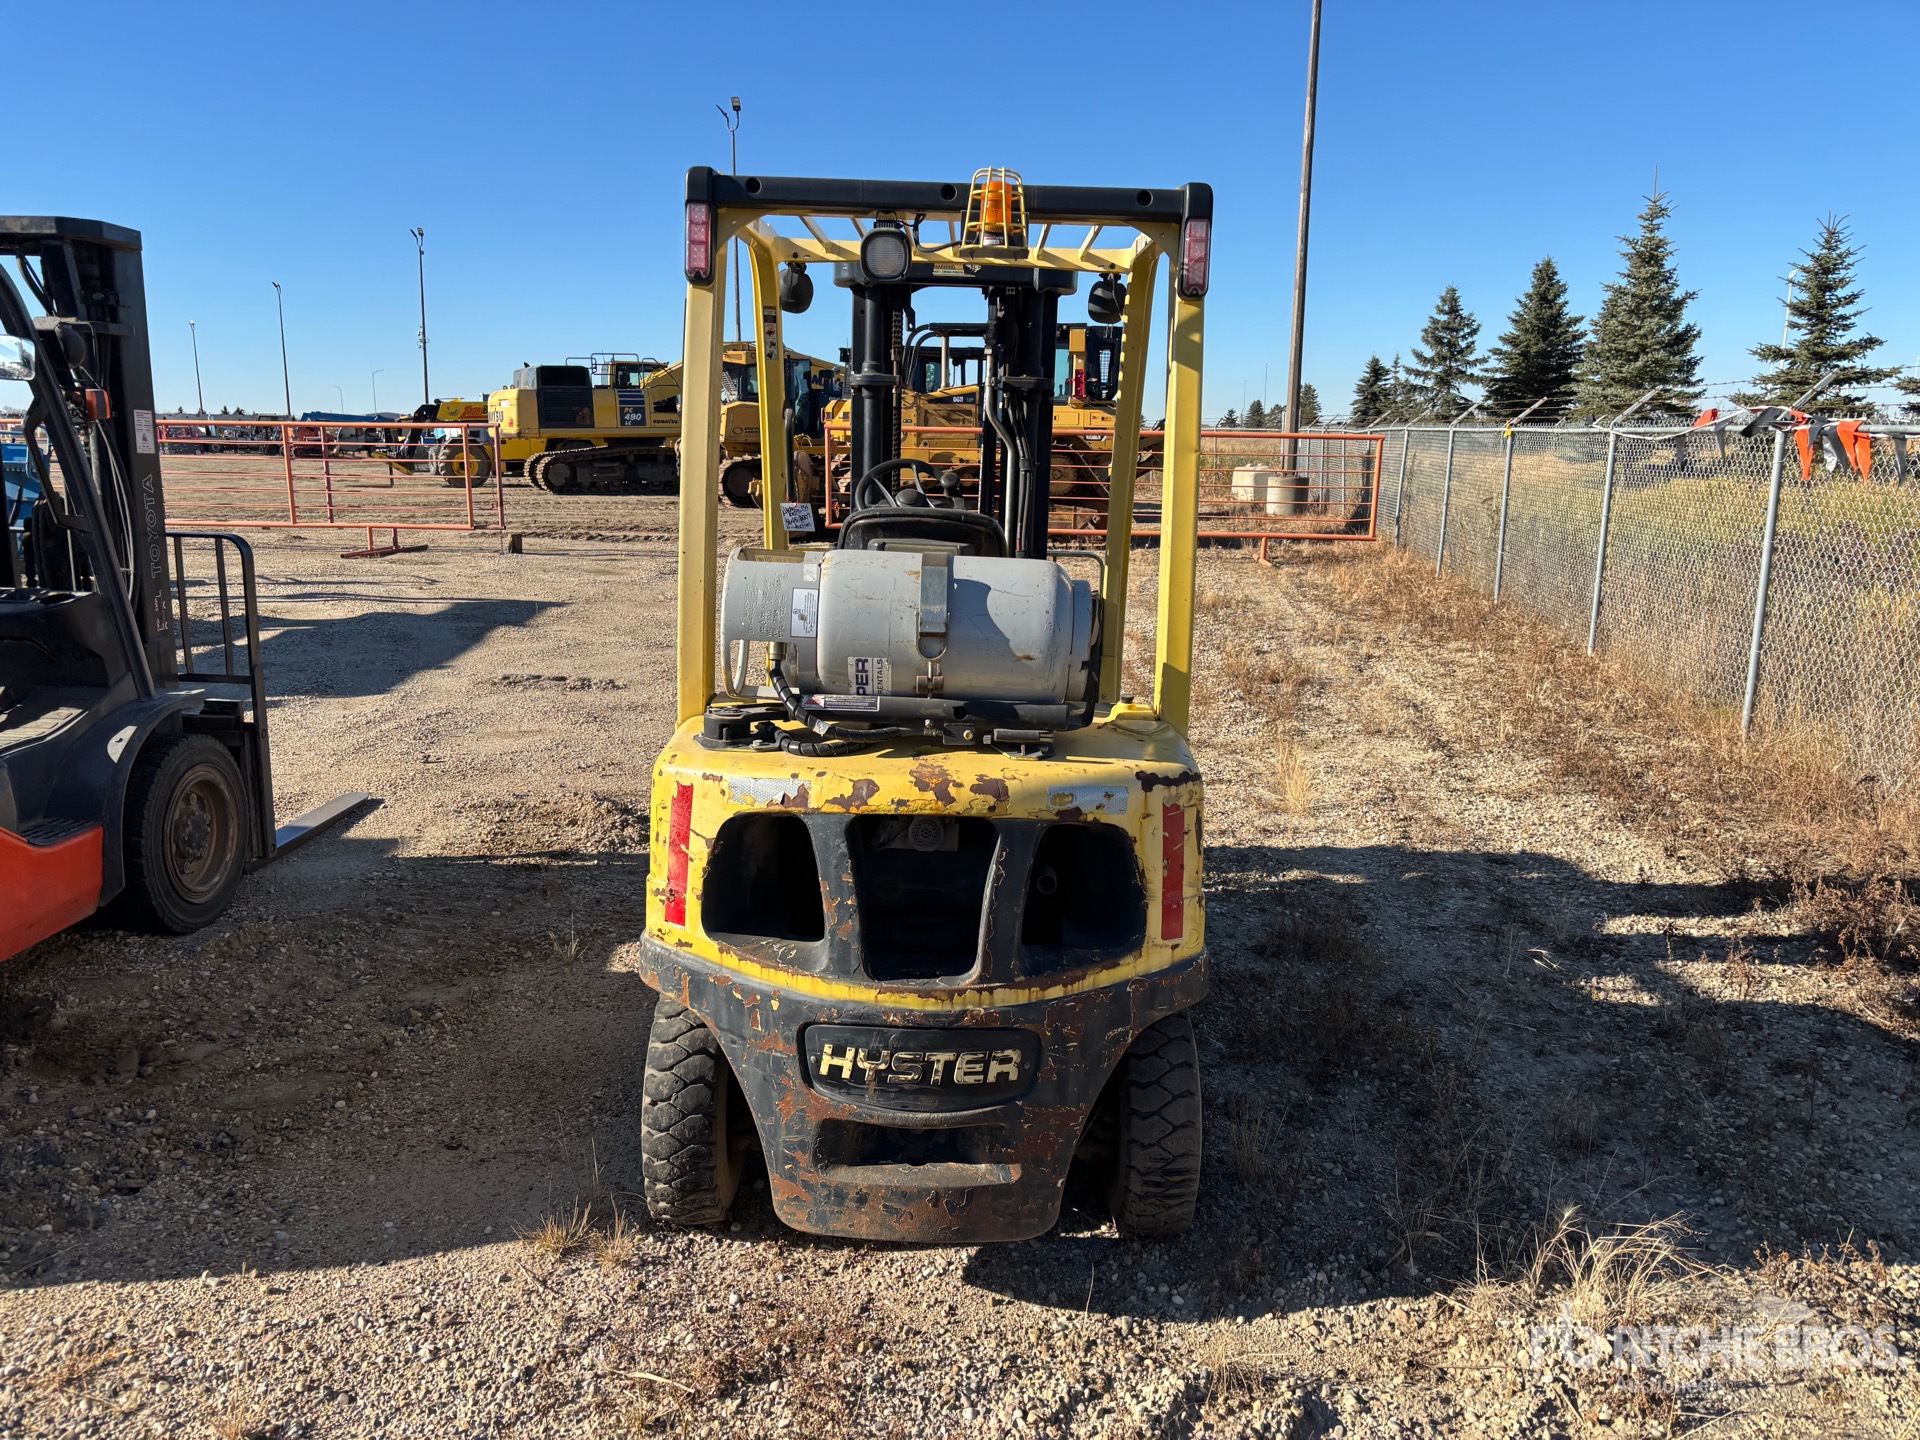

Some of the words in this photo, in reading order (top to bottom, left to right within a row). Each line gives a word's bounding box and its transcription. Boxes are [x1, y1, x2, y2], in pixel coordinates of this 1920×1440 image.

[624, 413, 642, 421] 490
[142, 474, 162, 579] TOYOTA
[876, 658, 884, 695] RENTALS
[819, 1043, 1022, 1086] HYSTER
